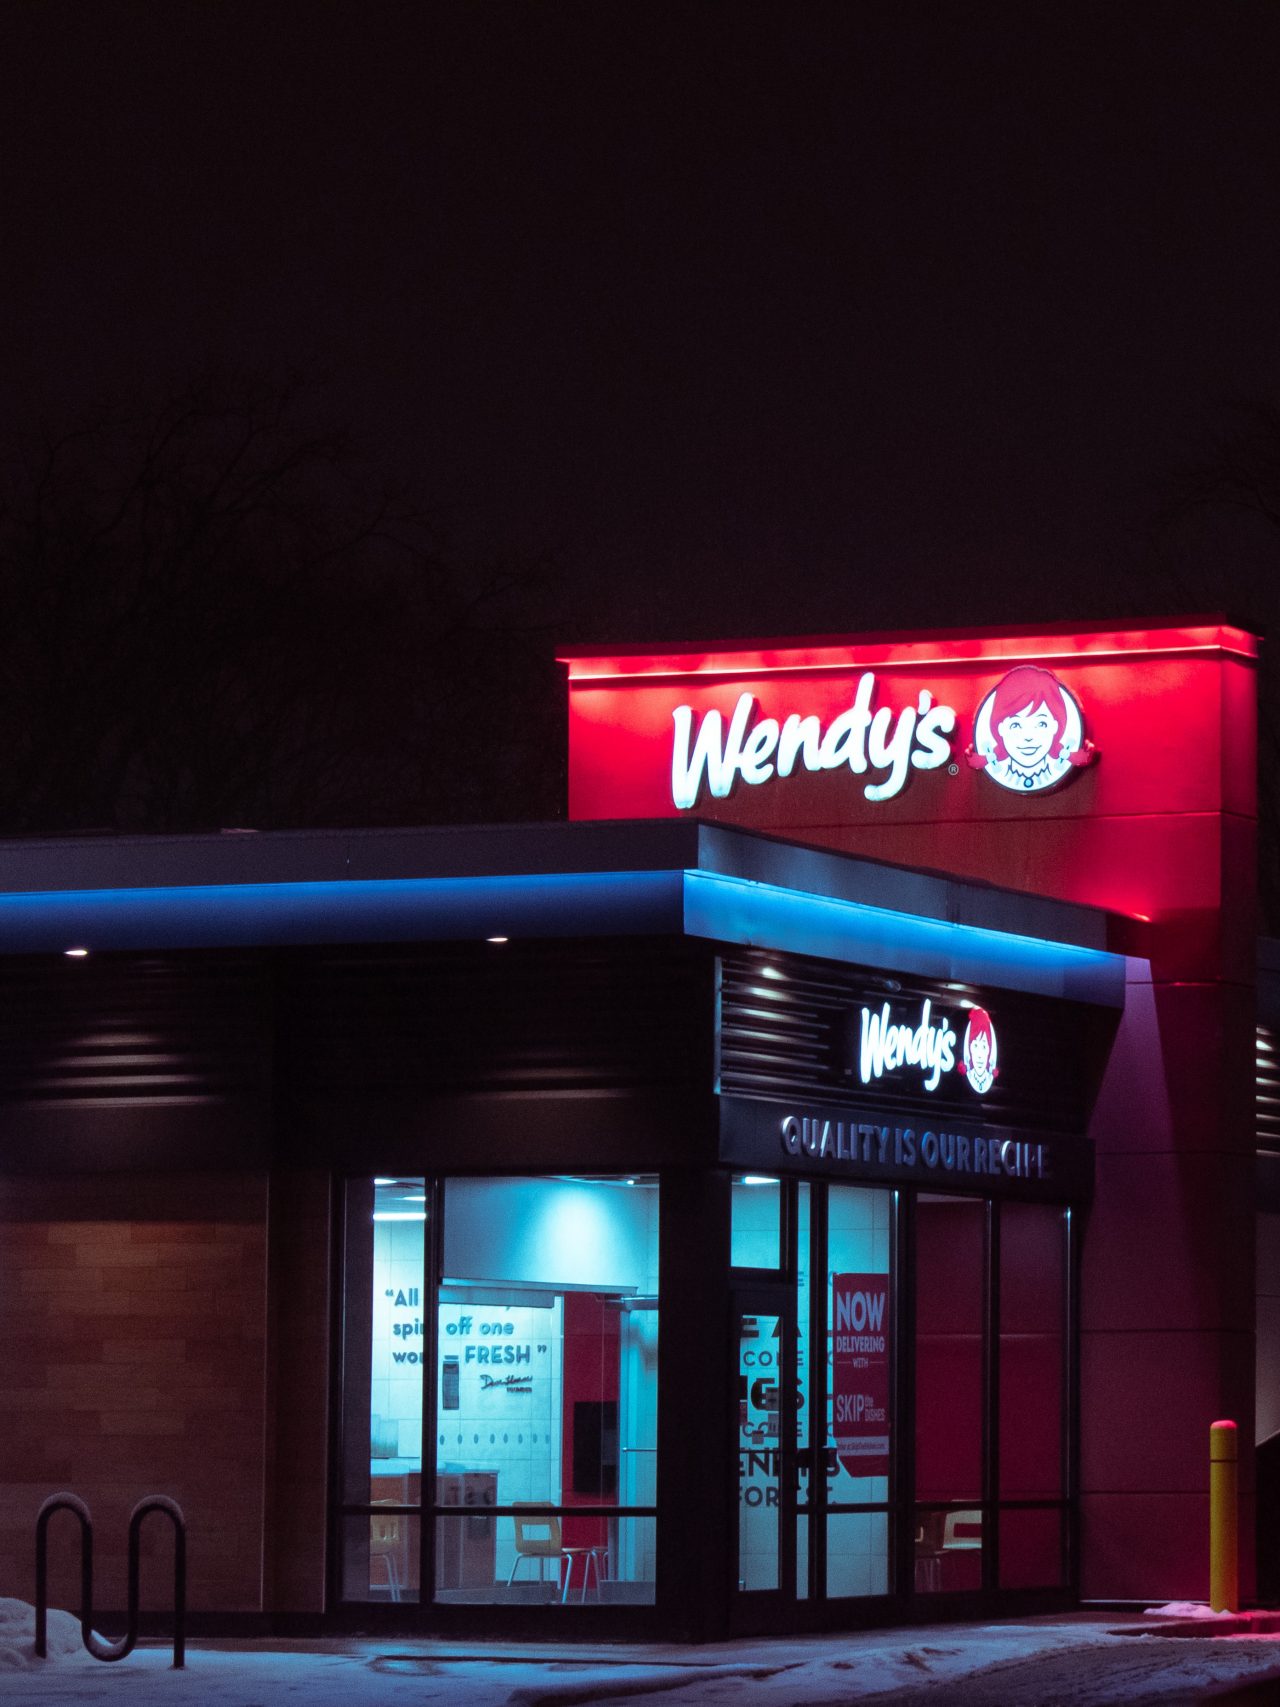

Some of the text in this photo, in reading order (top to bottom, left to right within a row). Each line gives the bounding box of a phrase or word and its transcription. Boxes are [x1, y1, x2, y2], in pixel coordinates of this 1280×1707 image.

[672, 672, 956, 809] Wendy's
[860, 999, 956, 1091] Wendy's
[781, 1115, 1050, 1179] QUALITY IS OUR RECIPE
[445, 1316, 473, 1335] off
[479, 1321, 514, 1336] one
[836, 1290, 886, 1332] NOW
[836, 1335, 886, 1353] DELIVERING
[852, 1356, 869, 1368] WITH
[836, 1392, 865, 1422] SKIP
